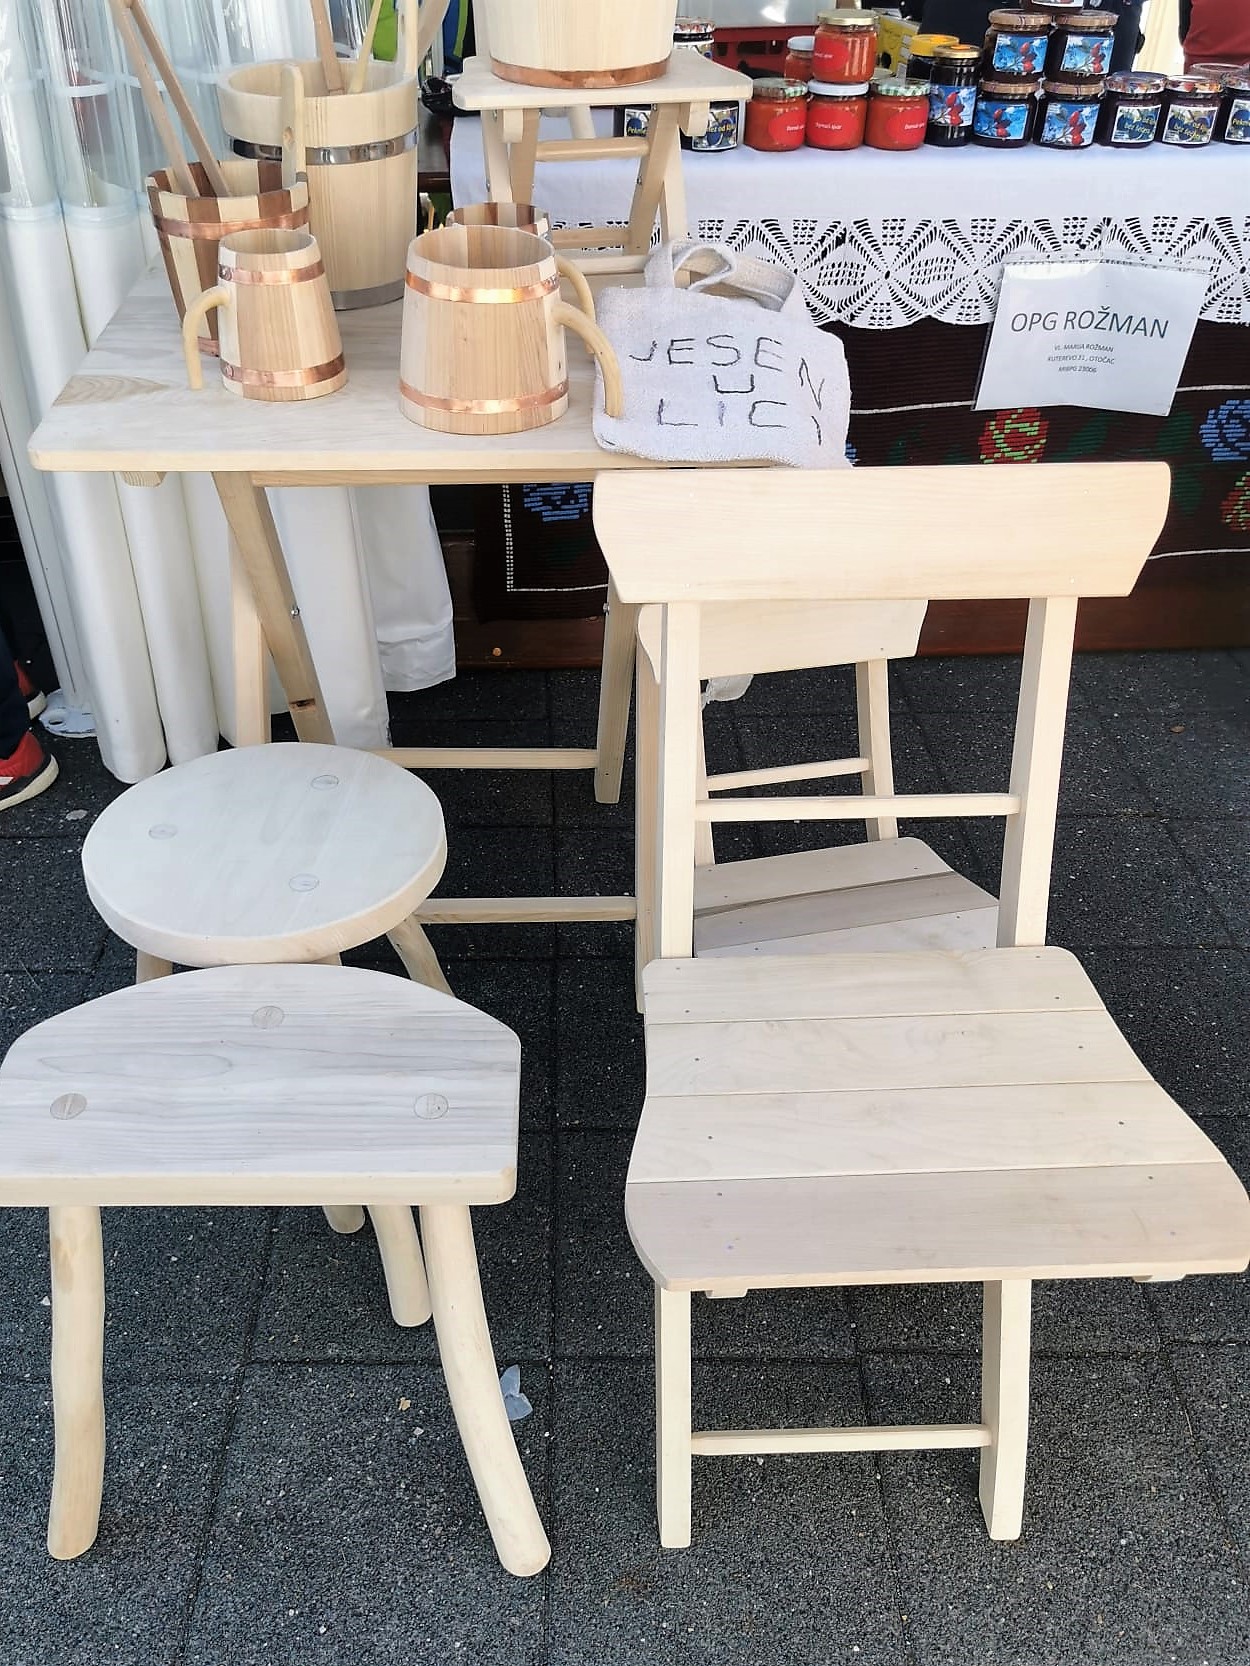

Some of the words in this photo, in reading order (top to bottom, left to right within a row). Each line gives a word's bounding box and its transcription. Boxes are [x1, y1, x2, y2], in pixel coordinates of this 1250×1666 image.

[1011, 311, 1059, 332] OPG
[1063, 305, 1169, 339] ROŽMAN
[1086, 343, 1114, 353] ROŽMAN
[1089, 355, 1115, 365] OTOČAC
[628, 334, 825, 411] JESEN
[711, 373, 755, 394] U
